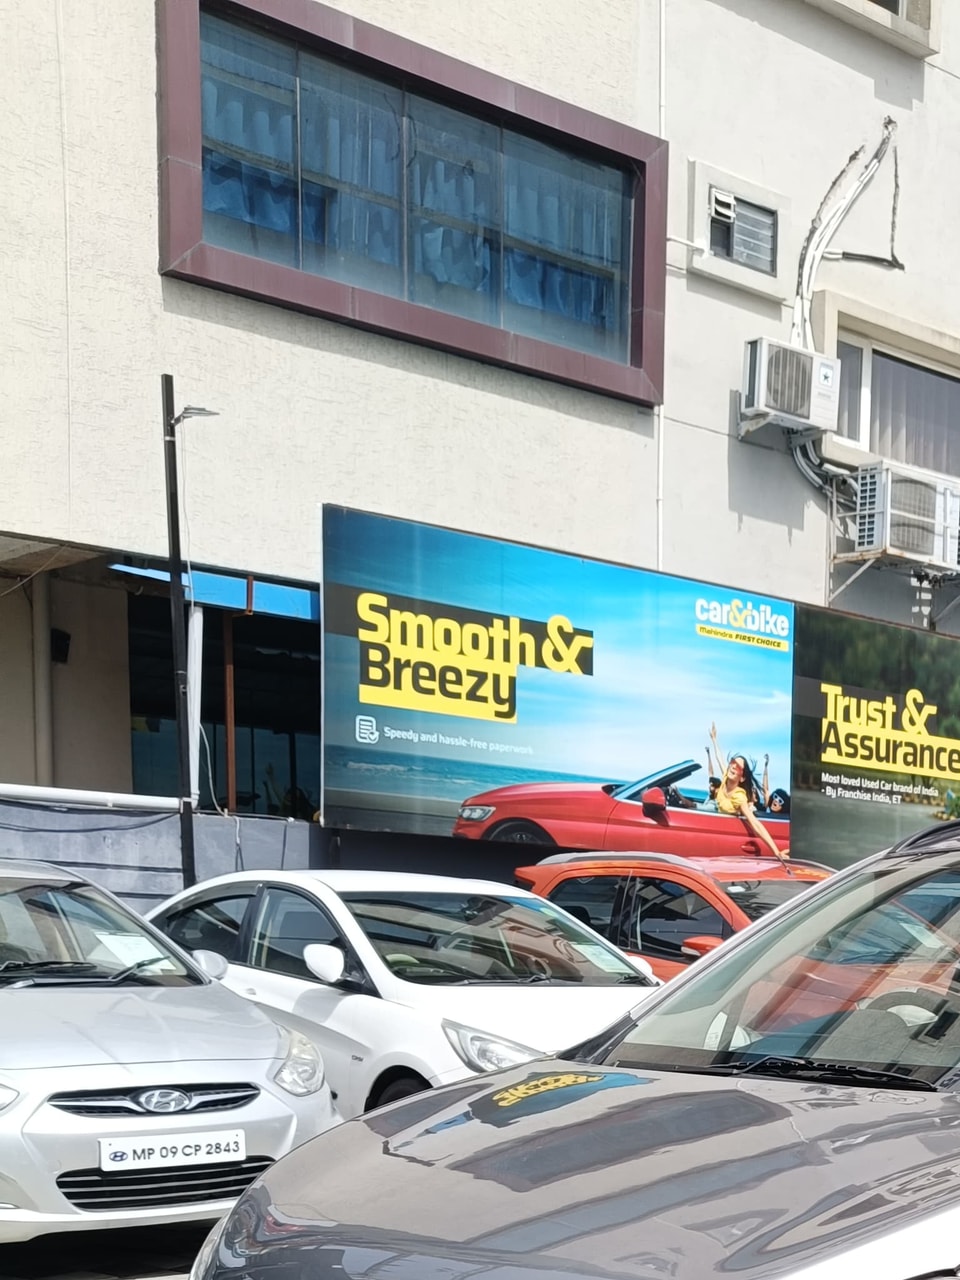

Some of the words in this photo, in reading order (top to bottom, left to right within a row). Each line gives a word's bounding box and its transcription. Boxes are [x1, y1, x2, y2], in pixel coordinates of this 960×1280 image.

[695, 598, 789, 637] car&bike
[356, 592, 536, 667] Smooth
[541, 614, 594, 675] &
[699, 626, 733, 639] Mahindra
[734, 633, 756, 643] FIRST
[756, 637, 782, 648] CHOICE
[360, 641, 517, 719] Breezy
[820, 682, 897, 730] Trust
[901, 688, 938, 737] &
[383, 726, 419, 742] Speedy
[420, 731, 438, 743] and
[439, 731, 488, 750] hassle-free
[489, 740, 534, 755] paperwork
[821, 772, 840, 784] Most
[841, 774, 861, 787] loved
[861, 778, 880, 790] Used
[880, 780, 892, 791] Car
[893, 782, 913, 794] brand
[913, 785, 921, 795] of
[922, 786, 939, 797] India
[825, 786, 836, 798] By
[837, 787, 872, 801] Franchise
[872, 791, 892, 804] India,
[892, 794, 903, 805] ET
[132, 1147, 155, 1162] MP
[159, 1145, 179, 1159] 09
[181, 1143, 202, 1157] CP
[206, 1140, 240, 1155] 2843
